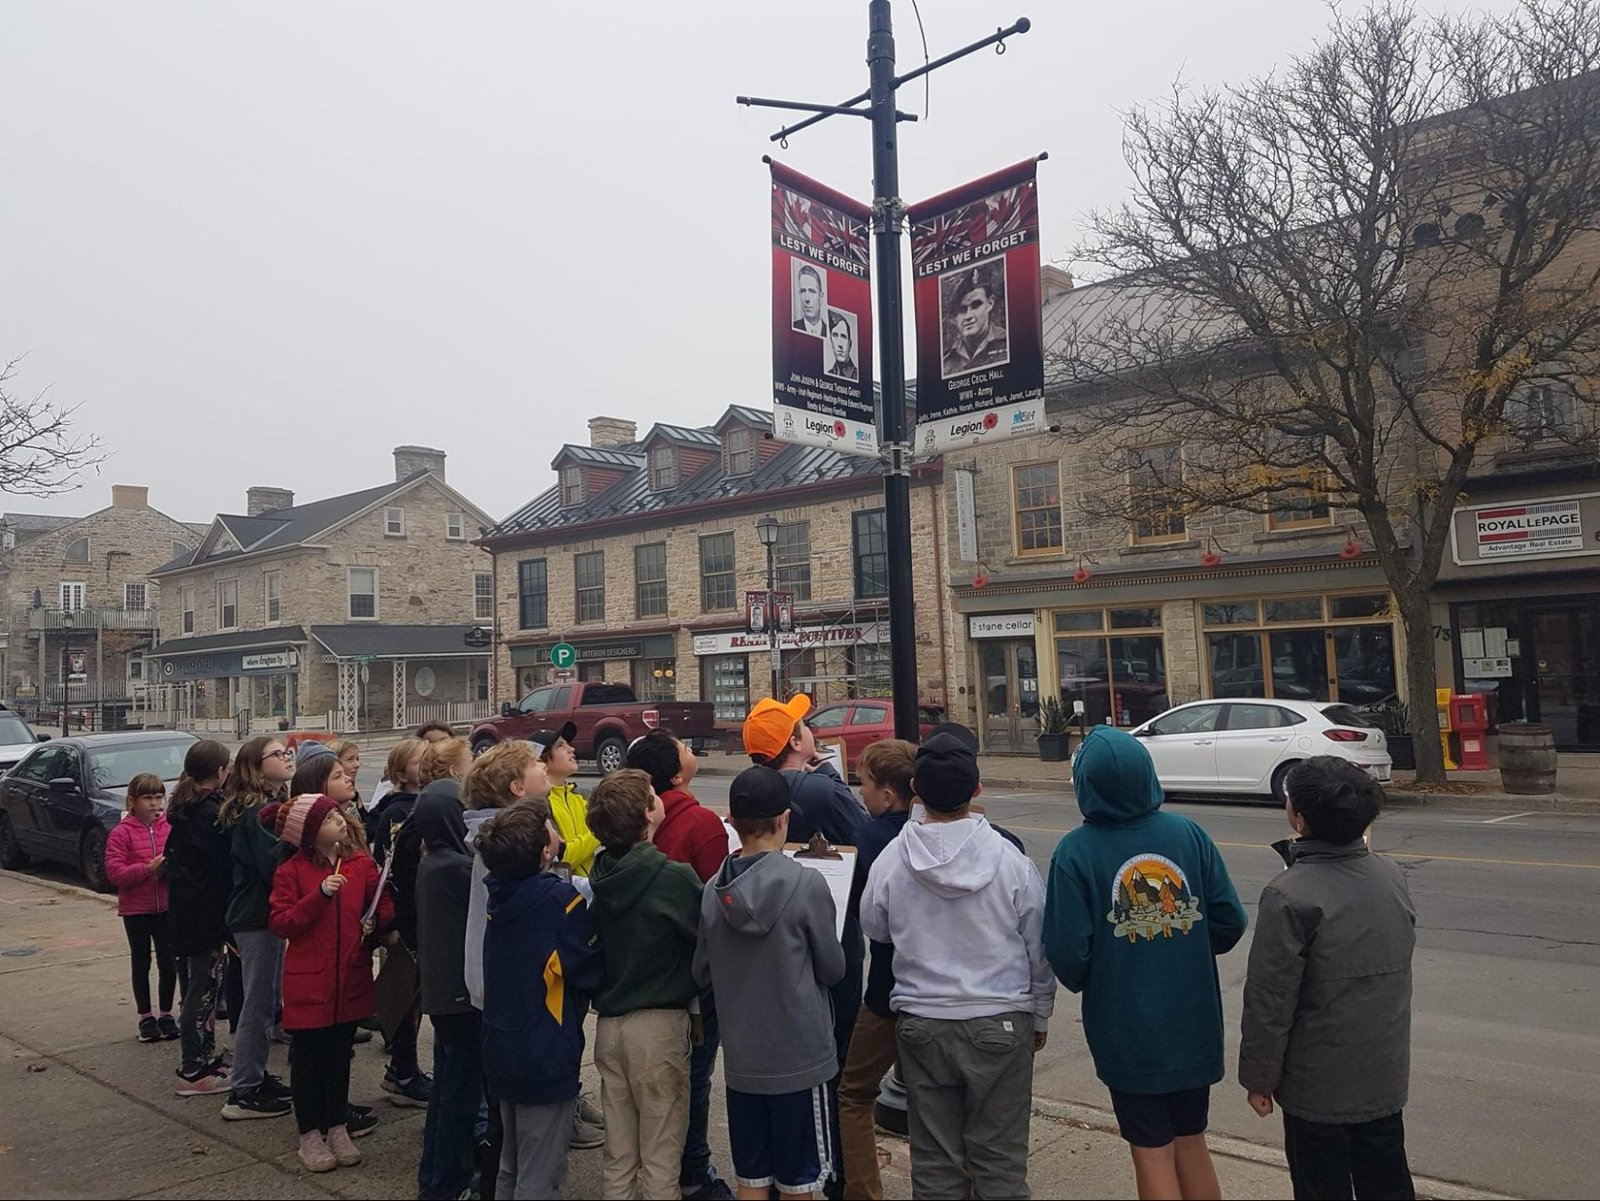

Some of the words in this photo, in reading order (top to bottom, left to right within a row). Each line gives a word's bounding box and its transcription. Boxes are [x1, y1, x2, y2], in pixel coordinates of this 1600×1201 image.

[780, 234, 806, 254] LEST
[808, 245, 825, 262] WE
[826, 253, 864, 277] FORGET
[919, 258, 949, 276] LEST
[952, 250, 971, 266] WE
[974, 230, 1027, 258] FORGET
[948, 378, 971, 392] GEORGE
[971, 374, 988, 386] CECIL
[988, 370, 1004, 381] HALL
[977, 386, 994, 398] Army
[806, 417, 834, 435] Legion
[950, 420, 982, 437] Legion
[1478, 520, 1526, 532] ROYAL
[1488, 542, 1527, 554] Advantage
[1529, 540, 1546, 549] Real
[1548, 538, 1573, 548] Estate
[978, 622, 1003, 632] stone
[1005, 620, 1033, 631] cellar
[1432, 625, 1451, 642] 73
[558, 649, 570, 664] P
[582, 649, 606, 660] INTERIOR
[607, 646, 637, 658] DESIGNERS
[1126, 919, 1190, 944] VANS
